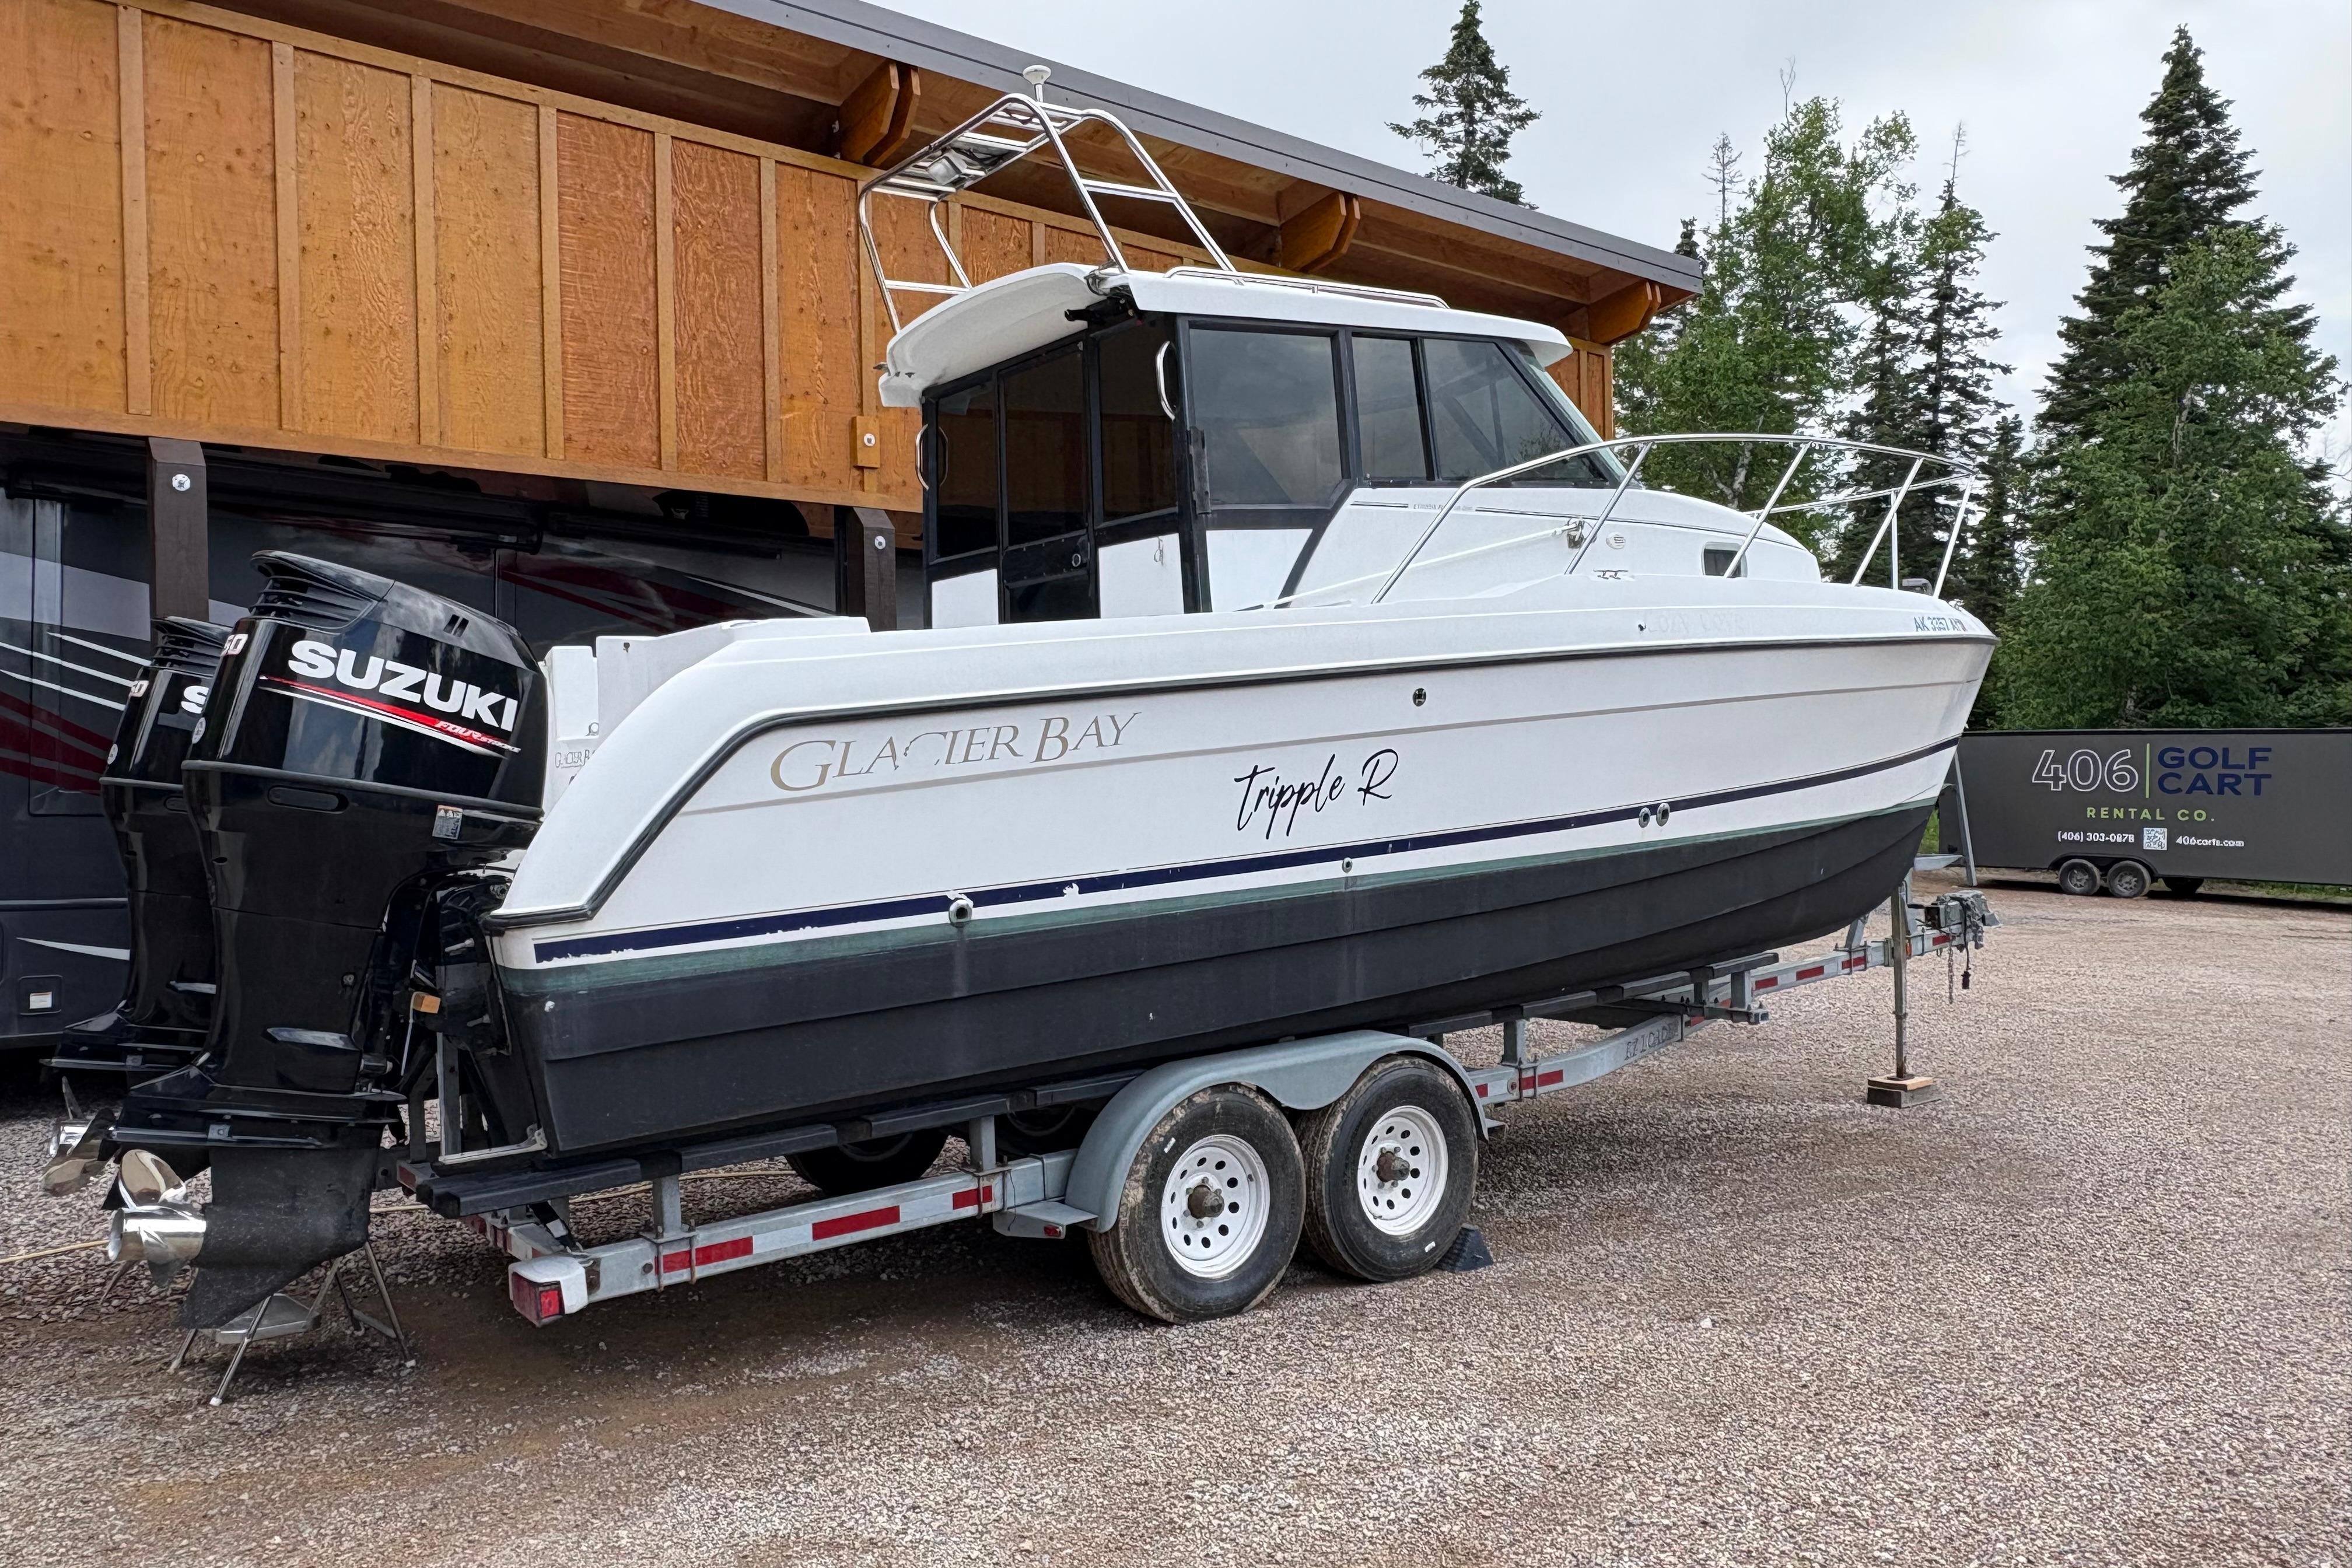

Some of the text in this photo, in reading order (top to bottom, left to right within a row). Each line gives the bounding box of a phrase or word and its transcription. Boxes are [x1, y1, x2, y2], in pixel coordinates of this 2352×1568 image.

[1914, 616, 1930, 632] AK
[288, 640, 519, 732] SUZUKI
[1030, 712, 1142, 764] BAY
[2032, 749, 2138, 792] 406
[2158, 747, 2272, 770] GOLF
[1357, 748, 1399, 806] R
[2158, 772, 2272, 796] CART
[2086, 807, 2215, 822] RENTAL CO.
[2057, 831, 2084, 842] (406)
